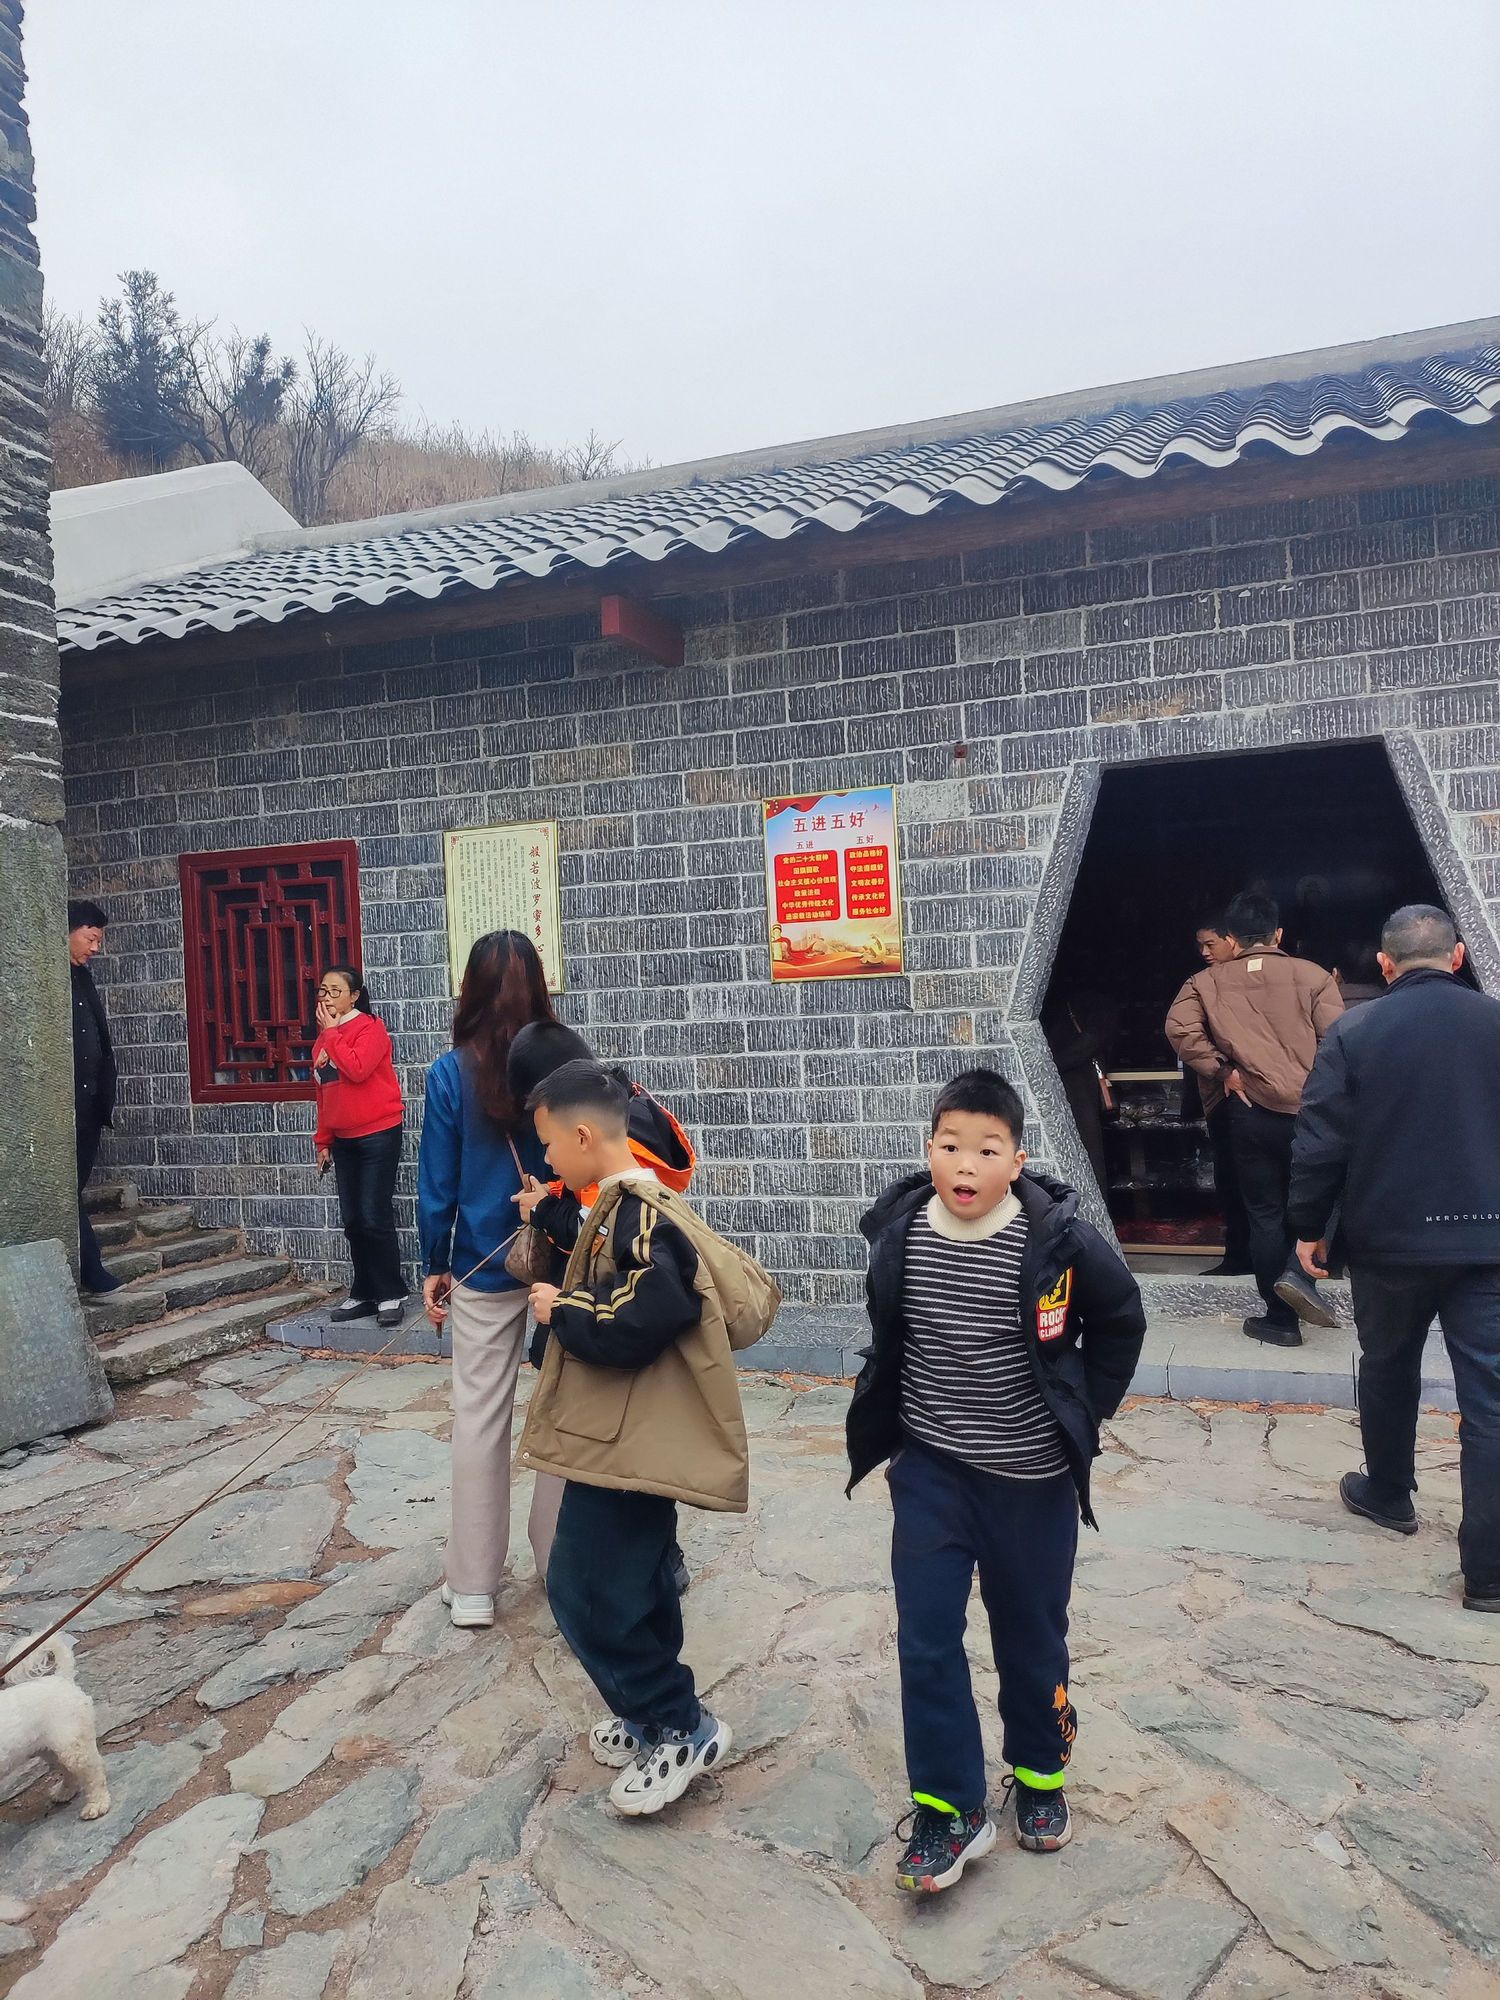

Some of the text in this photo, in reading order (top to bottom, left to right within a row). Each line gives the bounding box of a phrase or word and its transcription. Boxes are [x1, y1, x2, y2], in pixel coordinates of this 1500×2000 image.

[793, 812, 865, 832] 五进五好
[856, 835, 874, 844] 五好
[796, 841, 813, 849] 五进
[782, 854, 829, 864] 党的二十大精神
[793, 866, 819, 874] 国旗国歌
[778, 876, 836, 887] 社会主义核心价值观
[529, 845, 545, 969] 般若波罗蜜多心
[782, 899, 834, 909] 中华优秀传统文化
[1040, 1307, 1067, 1327] ROCK
